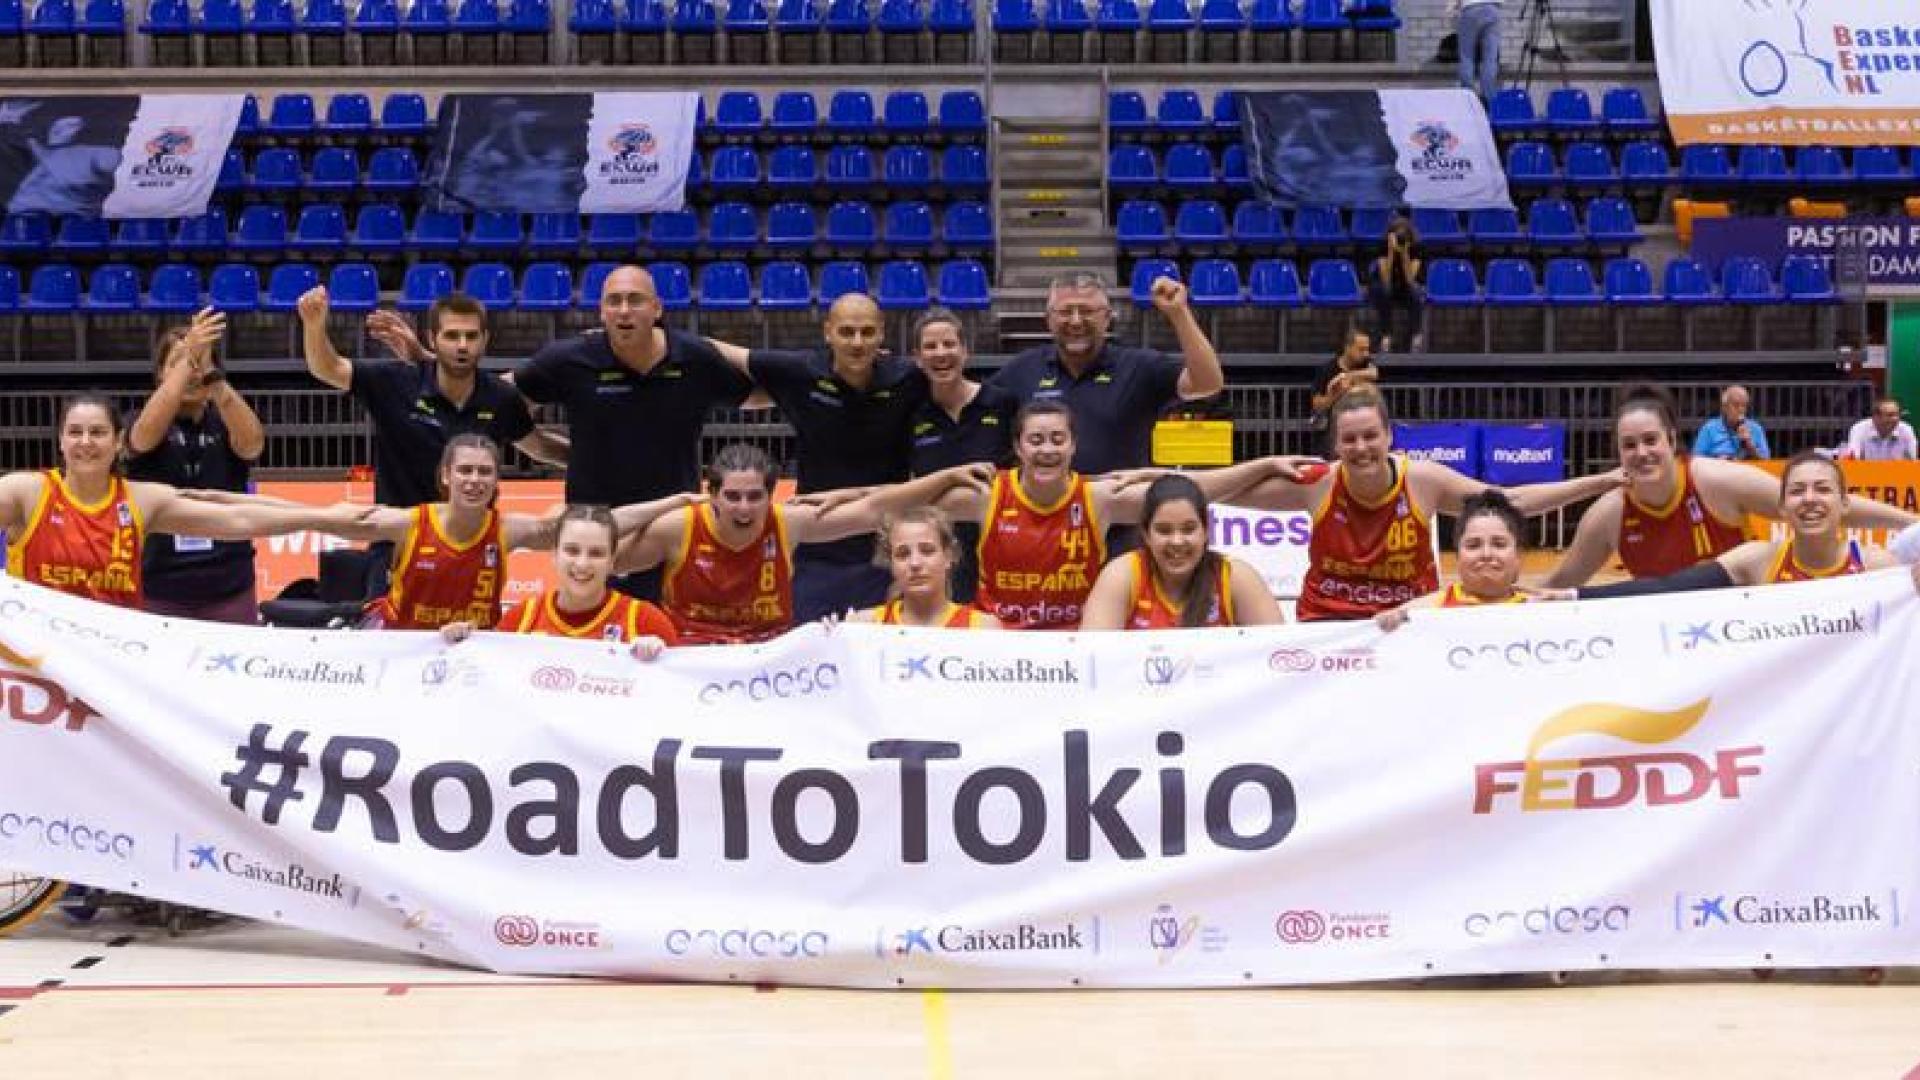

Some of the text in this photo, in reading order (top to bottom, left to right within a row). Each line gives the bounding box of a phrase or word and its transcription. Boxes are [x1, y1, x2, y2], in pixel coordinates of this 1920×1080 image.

[1846, 74, 1881, 94] NL
[1407, 447, 1466, 461] molten
[1494, 448, 1553, 463] molten
[1062, 528, 1088, 560] 44
[760, 561, 776, 591] 8
[1722, 609, 1864, 643] CaixaBank
[245, 656, 365, 684] CaixaBank
[938, 655, 1079, 684] CaixaBank
[1322, 656, 1376, 671] ONCE
[579, 682, 634, 697] ONCE
[220, 723, 1297, 865] #RoadToTokio
[1473, 746, 1764, 814] FEDDF
[223, 851, 343, 898] CaixaBank
[1734, 895, 1881, 924] CaixaBank
[543, 931, 599, 947] ONCE
[938, 924, 1082, 952] CaixaBank
[1330, 924, 1389, 940] ONCE
